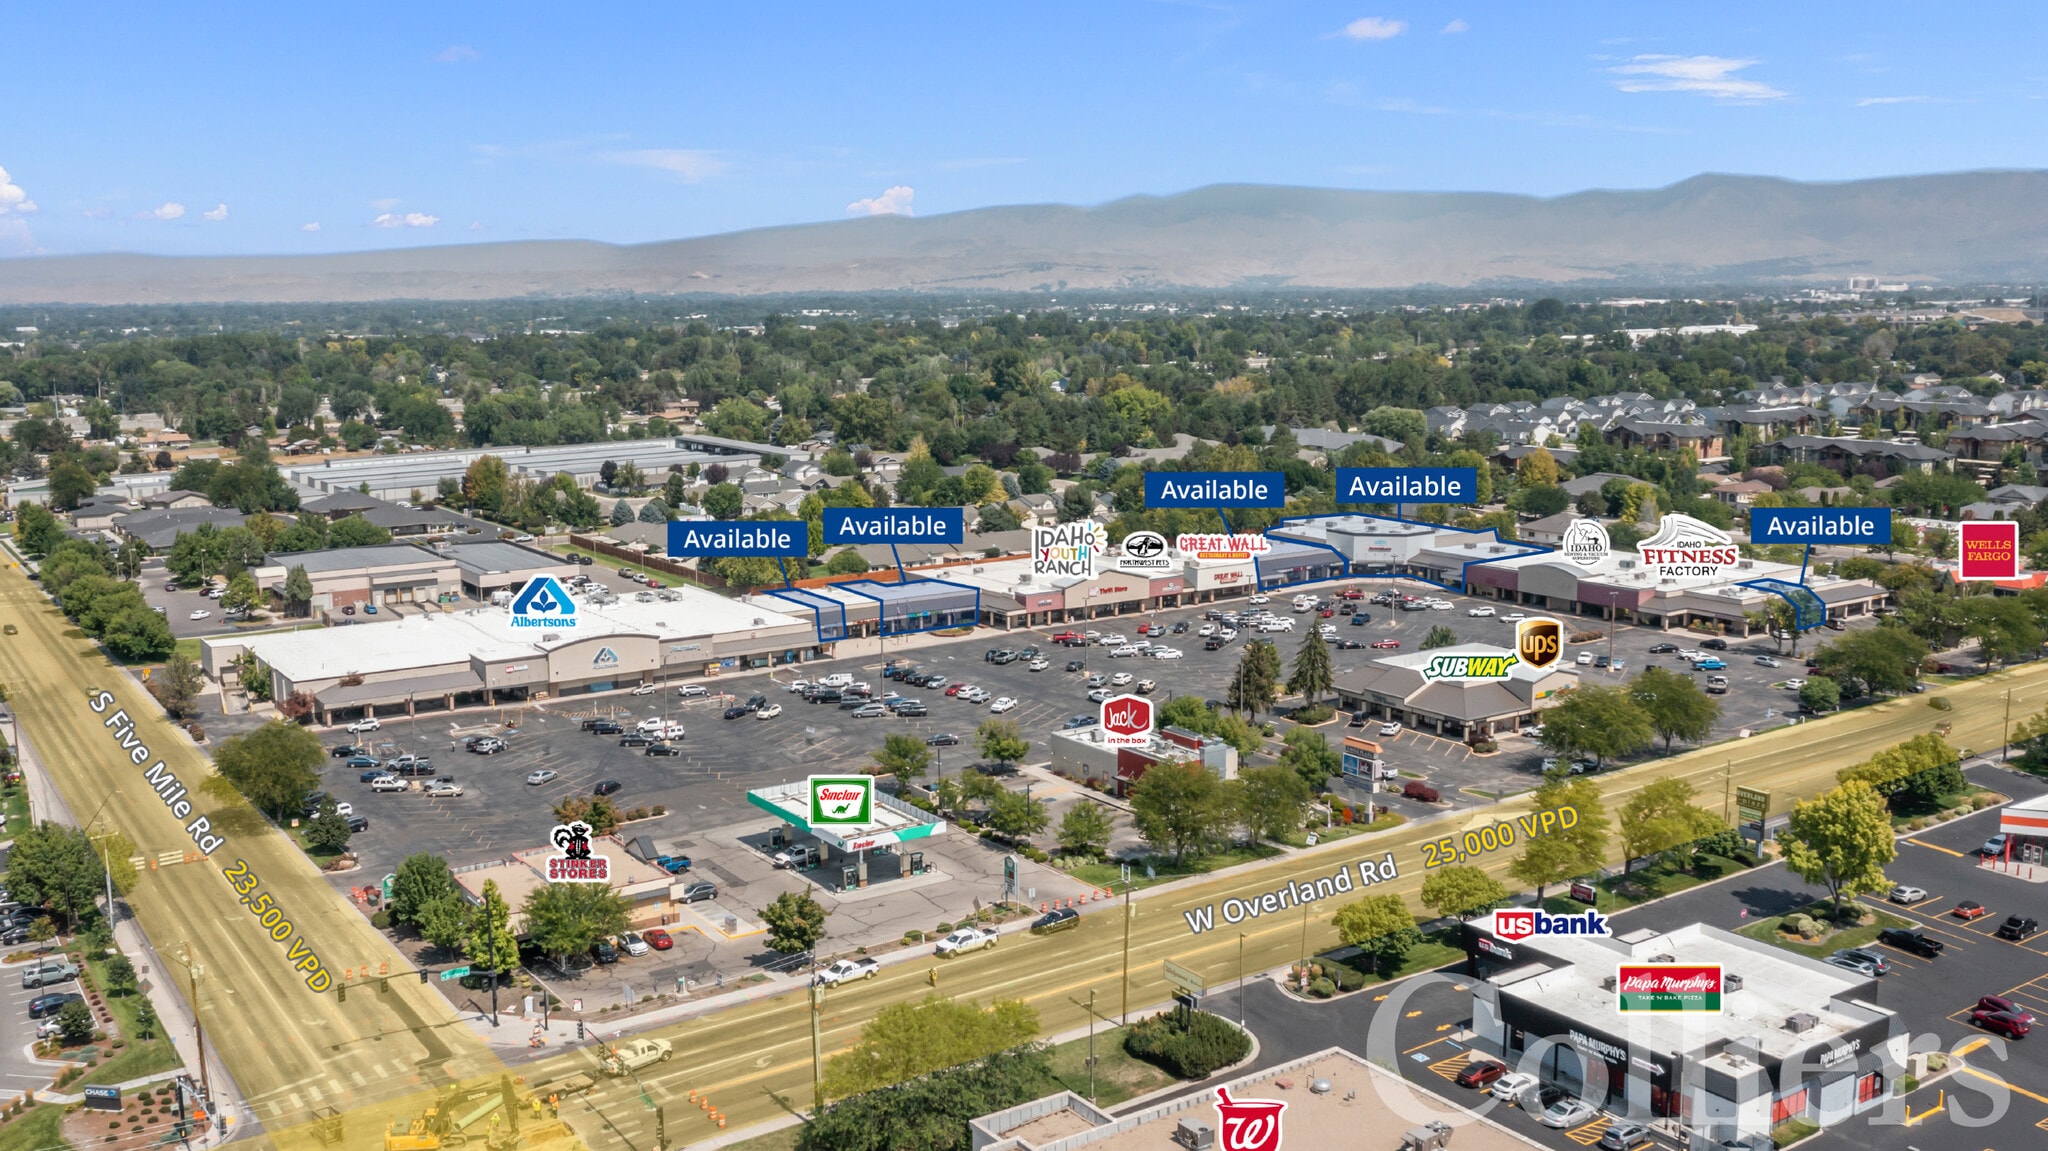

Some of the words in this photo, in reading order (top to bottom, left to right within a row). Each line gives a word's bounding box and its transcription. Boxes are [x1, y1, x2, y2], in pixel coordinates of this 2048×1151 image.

[852, 840, 875, 850] Sinclair
[1569, 1029, 1588, 1046] PAPA
[1588, 1037, 1627, 1061] MURPHY'S
[85, 1089, 109, 1097] CHASE
